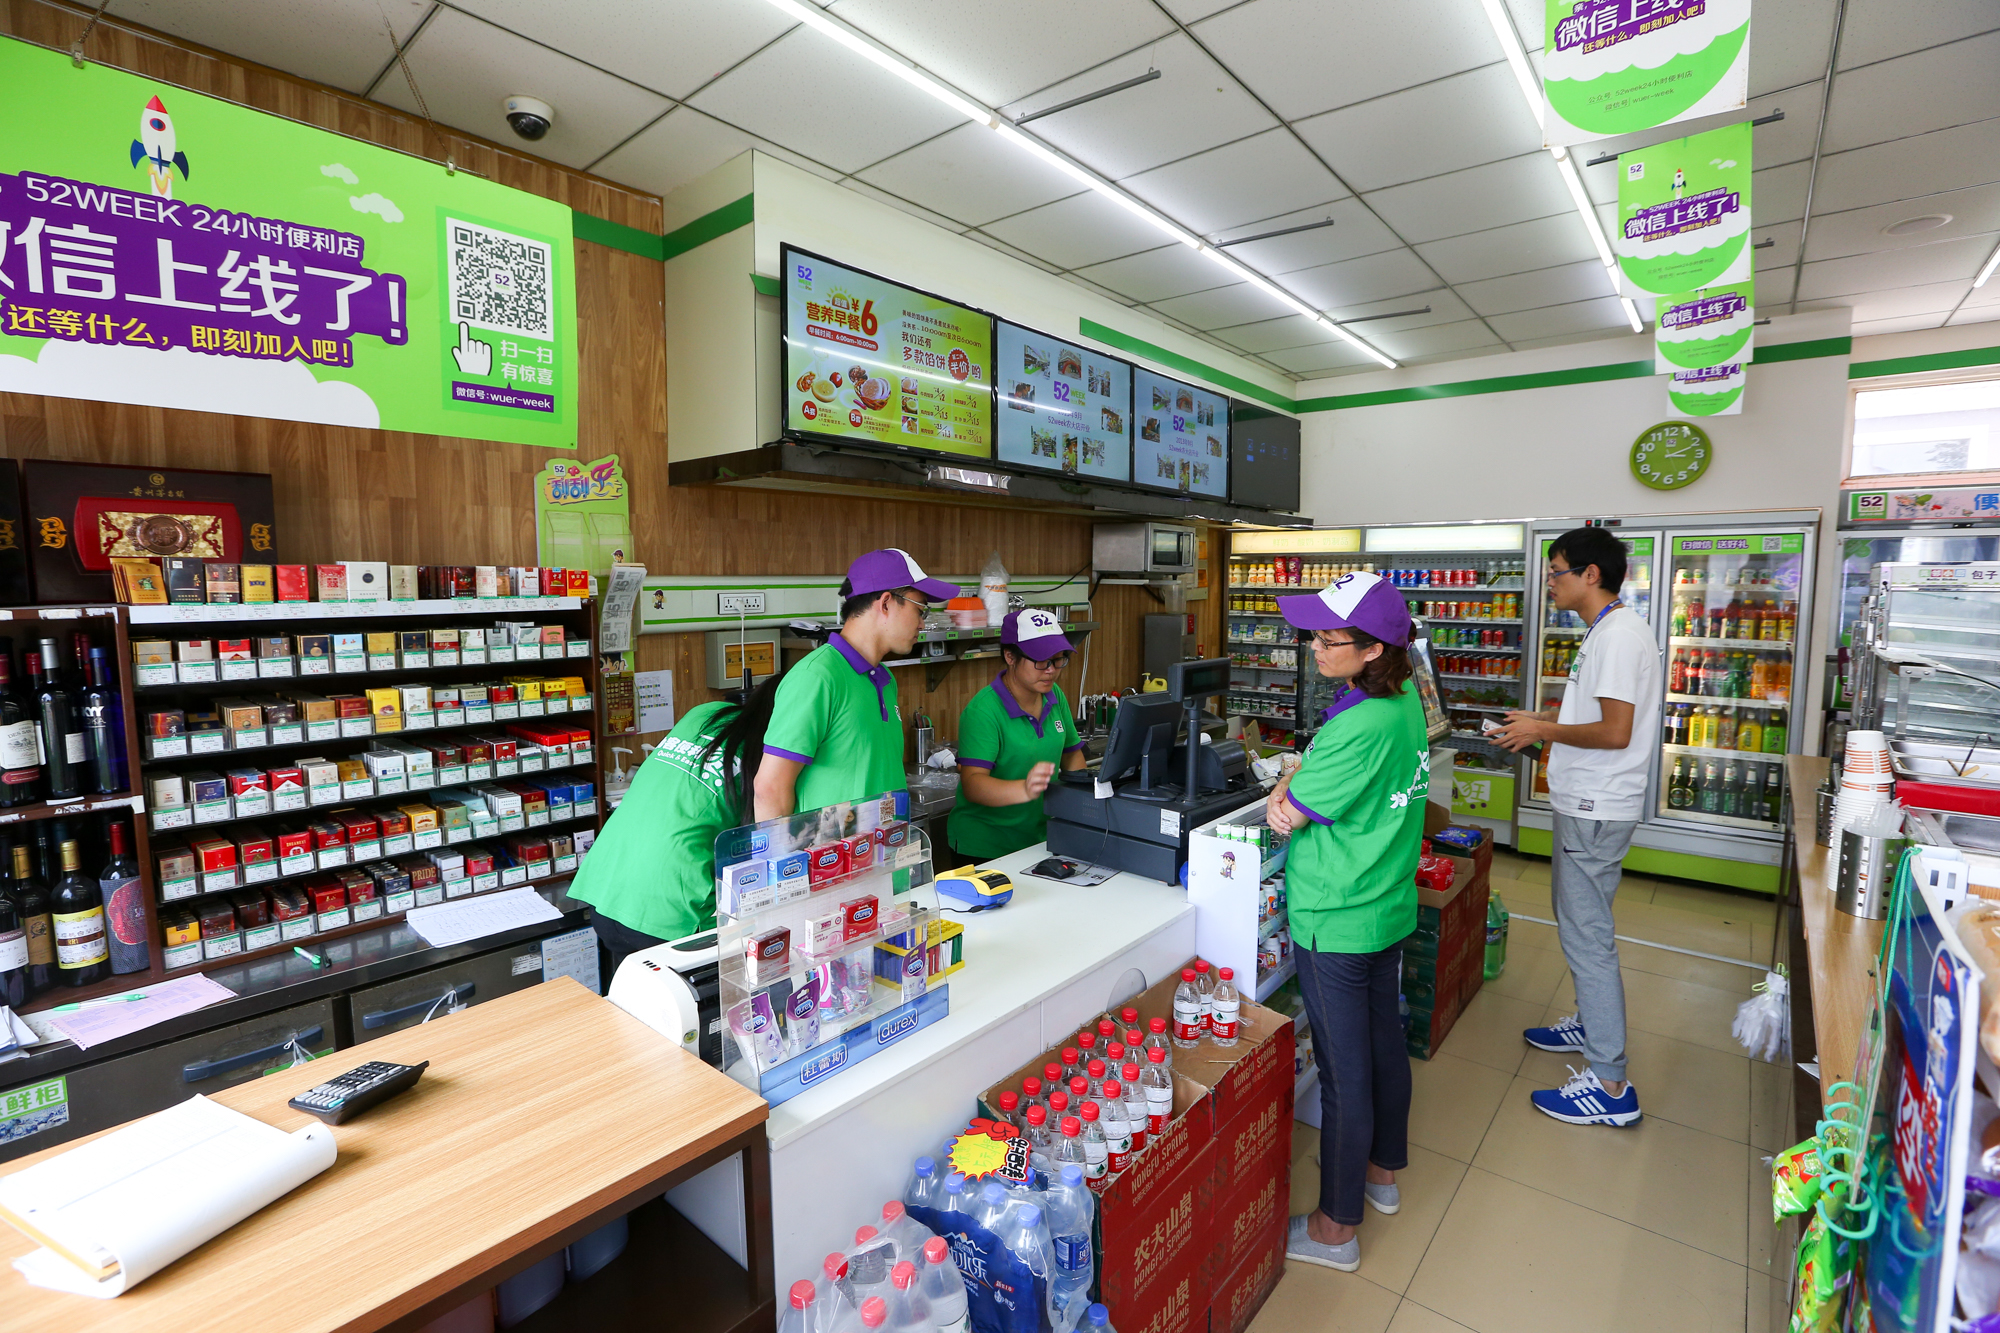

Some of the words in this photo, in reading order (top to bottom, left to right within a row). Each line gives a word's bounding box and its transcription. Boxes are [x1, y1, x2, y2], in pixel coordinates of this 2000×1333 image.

[1630, 164, 1643, 174] 52
[26, 176, 183, 227] 52WEEK
[191, 209, 359, 258] 24小时便利店
[1625, 193, 1738, 237] 微信上线了！
[494, 273, 510, 286] 52
[797, 264, 812, 281] 52
[806, 301, 861, 332] 营养早餐
[1662, 298, 1746, 328] 微信上线了！
[8, 304, 349, 364] 还等什么，即刻加入吧！
[901, 331, 932, 348] 我们还有
[501, 339, 553, 364] 扫一扫
[902, 346, 946, 371] 多款馅饼
[950, 361, 968, 374] 半价
[501, 362, 554, 386] 有惊喜
[1053, 380, 1070, 402] 52
[1173, 414, 1185, 433] 52
[1651, 432, 1662, 442] 11
[1664, 427, 1679, 437] 12
[1640, 442, 1655, 452] 10
[1691, 437, 1700, 447] 2
[1636, 453, 1646, 463] 9
[1694, 449, 1705, 458] 3
[1640, 464, 1650, 474] 8
[1687, 461, 1699, 471] 4
[1651, 472, 1661, 482] 7
[1663, 474, 1673, 484] 6
[1677, 471, 1688, 480] 5
[1860, 496, 1882, 507] 52
[1682, 540, 1713, 550] 扫微信
[1716, 538, 1749, 549] 送好礼
[1972, 570, 1998, 580] 包子
[1031, 614, 1052, 627] 52
[657, 750, 674, 760] Quick
[680, 757, 700, 769] Easy
[890, 832, 904, 843] durex
[856, 843, 870, 855] durex
[819, 854, 838, 866] durex
[411, 866, 436, 882] PRIDE
[784, 863, 802, 875] durex
[739, 873, 759, 885] durex
[855, 908, 873, 921] durex
[765, 943, 784, 955] durex
[907, 961, 923, 973] durex
[796, 1001, 813, 1015] durex
[881, 1012, 917, 1039] durex
[804, 1049, 845, 1078] 杜蕾斯
[1233, 1060, 1255, 1090] NONGFU
[1257, 1043, 1277, 1069] SPRING
[0, 1081, 61, 1117] 鲜柜
[1234, 1101, 1278, 1161] 农夫山泉
[1234, 1147, 1256, 1176] NONGFU
[1257, 1123, 1278, 1150] SPRING
[1131, 1154, 1159, 1194] NONGFU
[1161, 1128, 1188, 1161] SPRING
[1233, 1177, 1276, 1240] 农夫山泉
[1134, 1191, 1192, 1272] 农夫山泉
[1232, 1222, 1255, 1254] NONGFU
[1256, 1198, 1275, 1227] SPRING
[1134, 1246, 1164, 1290] NONGFU
[1166, 1216, 1192, 1253] SPRING
[1231, 1249, 1273, 1316] 农夫山泉
